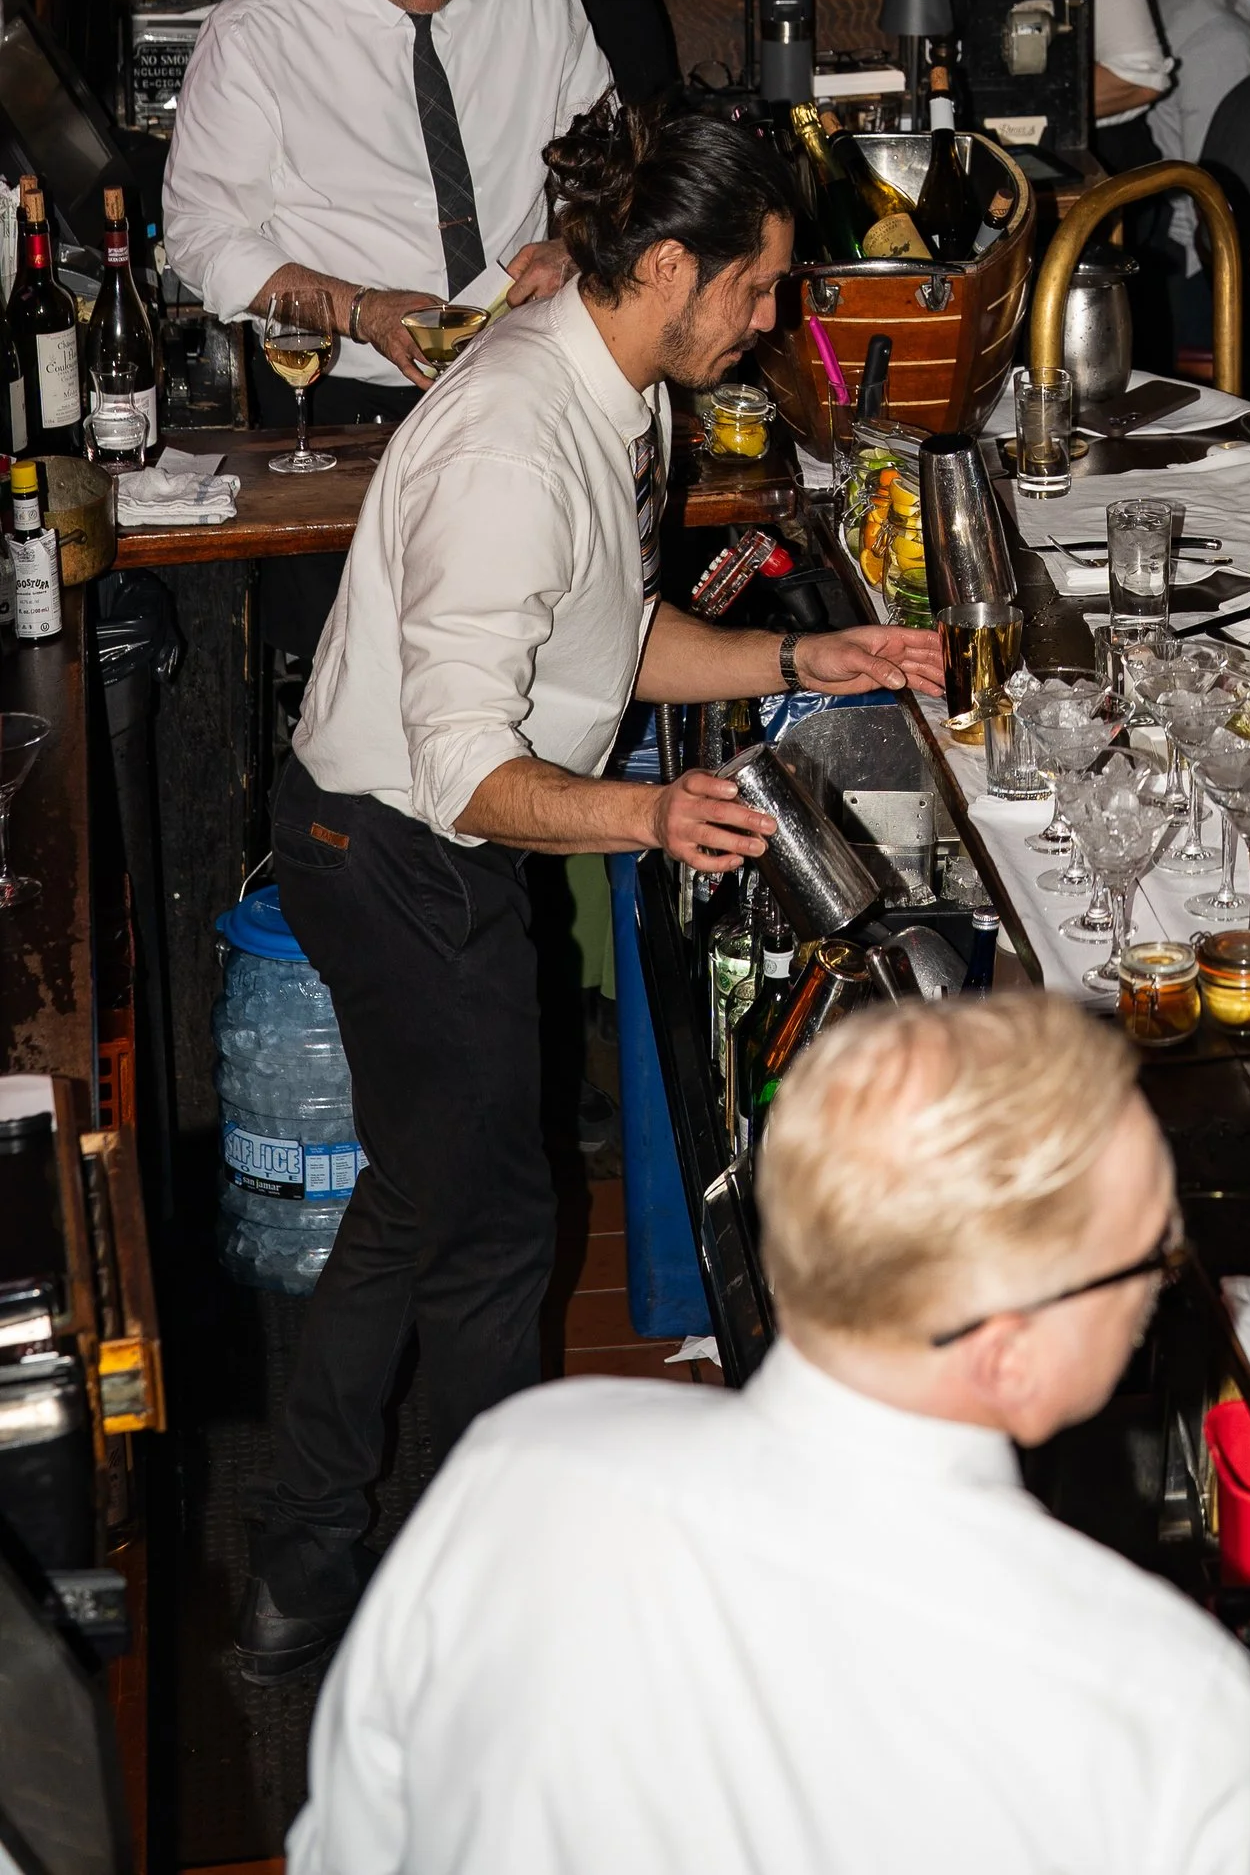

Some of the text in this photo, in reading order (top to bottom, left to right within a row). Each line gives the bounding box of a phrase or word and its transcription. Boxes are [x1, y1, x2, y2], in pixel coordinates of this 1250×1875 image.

[141, 55, 157, 65] NO
[133, 67, 182, 77] NCLUDES
[142, 78, 182, 89] E-CIGA
[16, 578, 50, 591] GOSTURA
[242, 1176, 255, 1187] san
[255, 1178, 282, 1192] jamar
